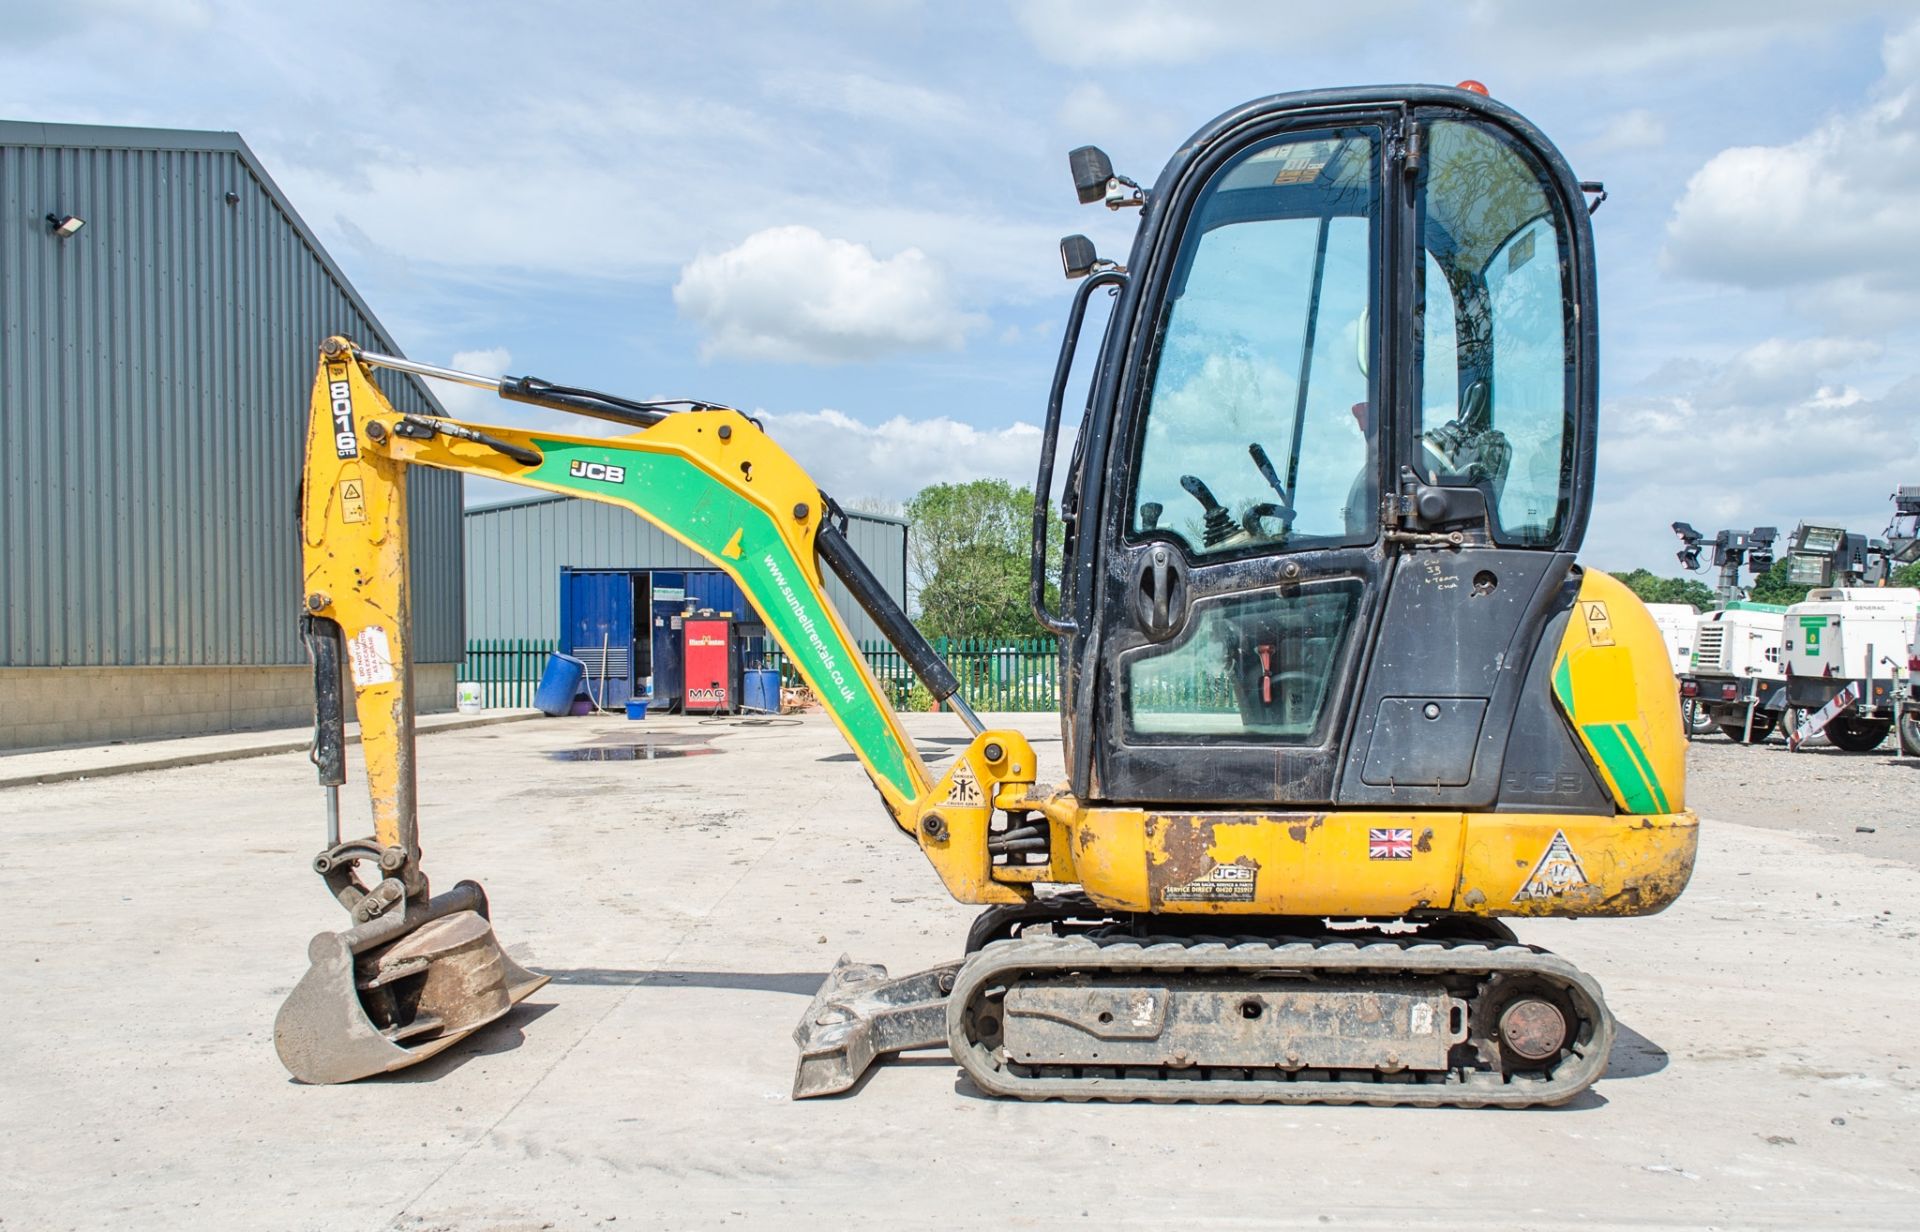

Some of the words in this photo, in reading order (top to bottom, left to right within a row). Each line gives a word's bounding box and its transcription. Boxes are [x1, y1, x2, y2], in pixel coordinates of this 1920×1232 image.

[330, 381, 356, 450] 8016
[571, 460, 625, 483] JCB
[764, 554, 855, 704] www.sunbeltrentals.co.uk
[689, 689, 725, 698] MAC
[1506, 771, 1584, 794] JCB
[1213, 869, 1250, 879] JCB
